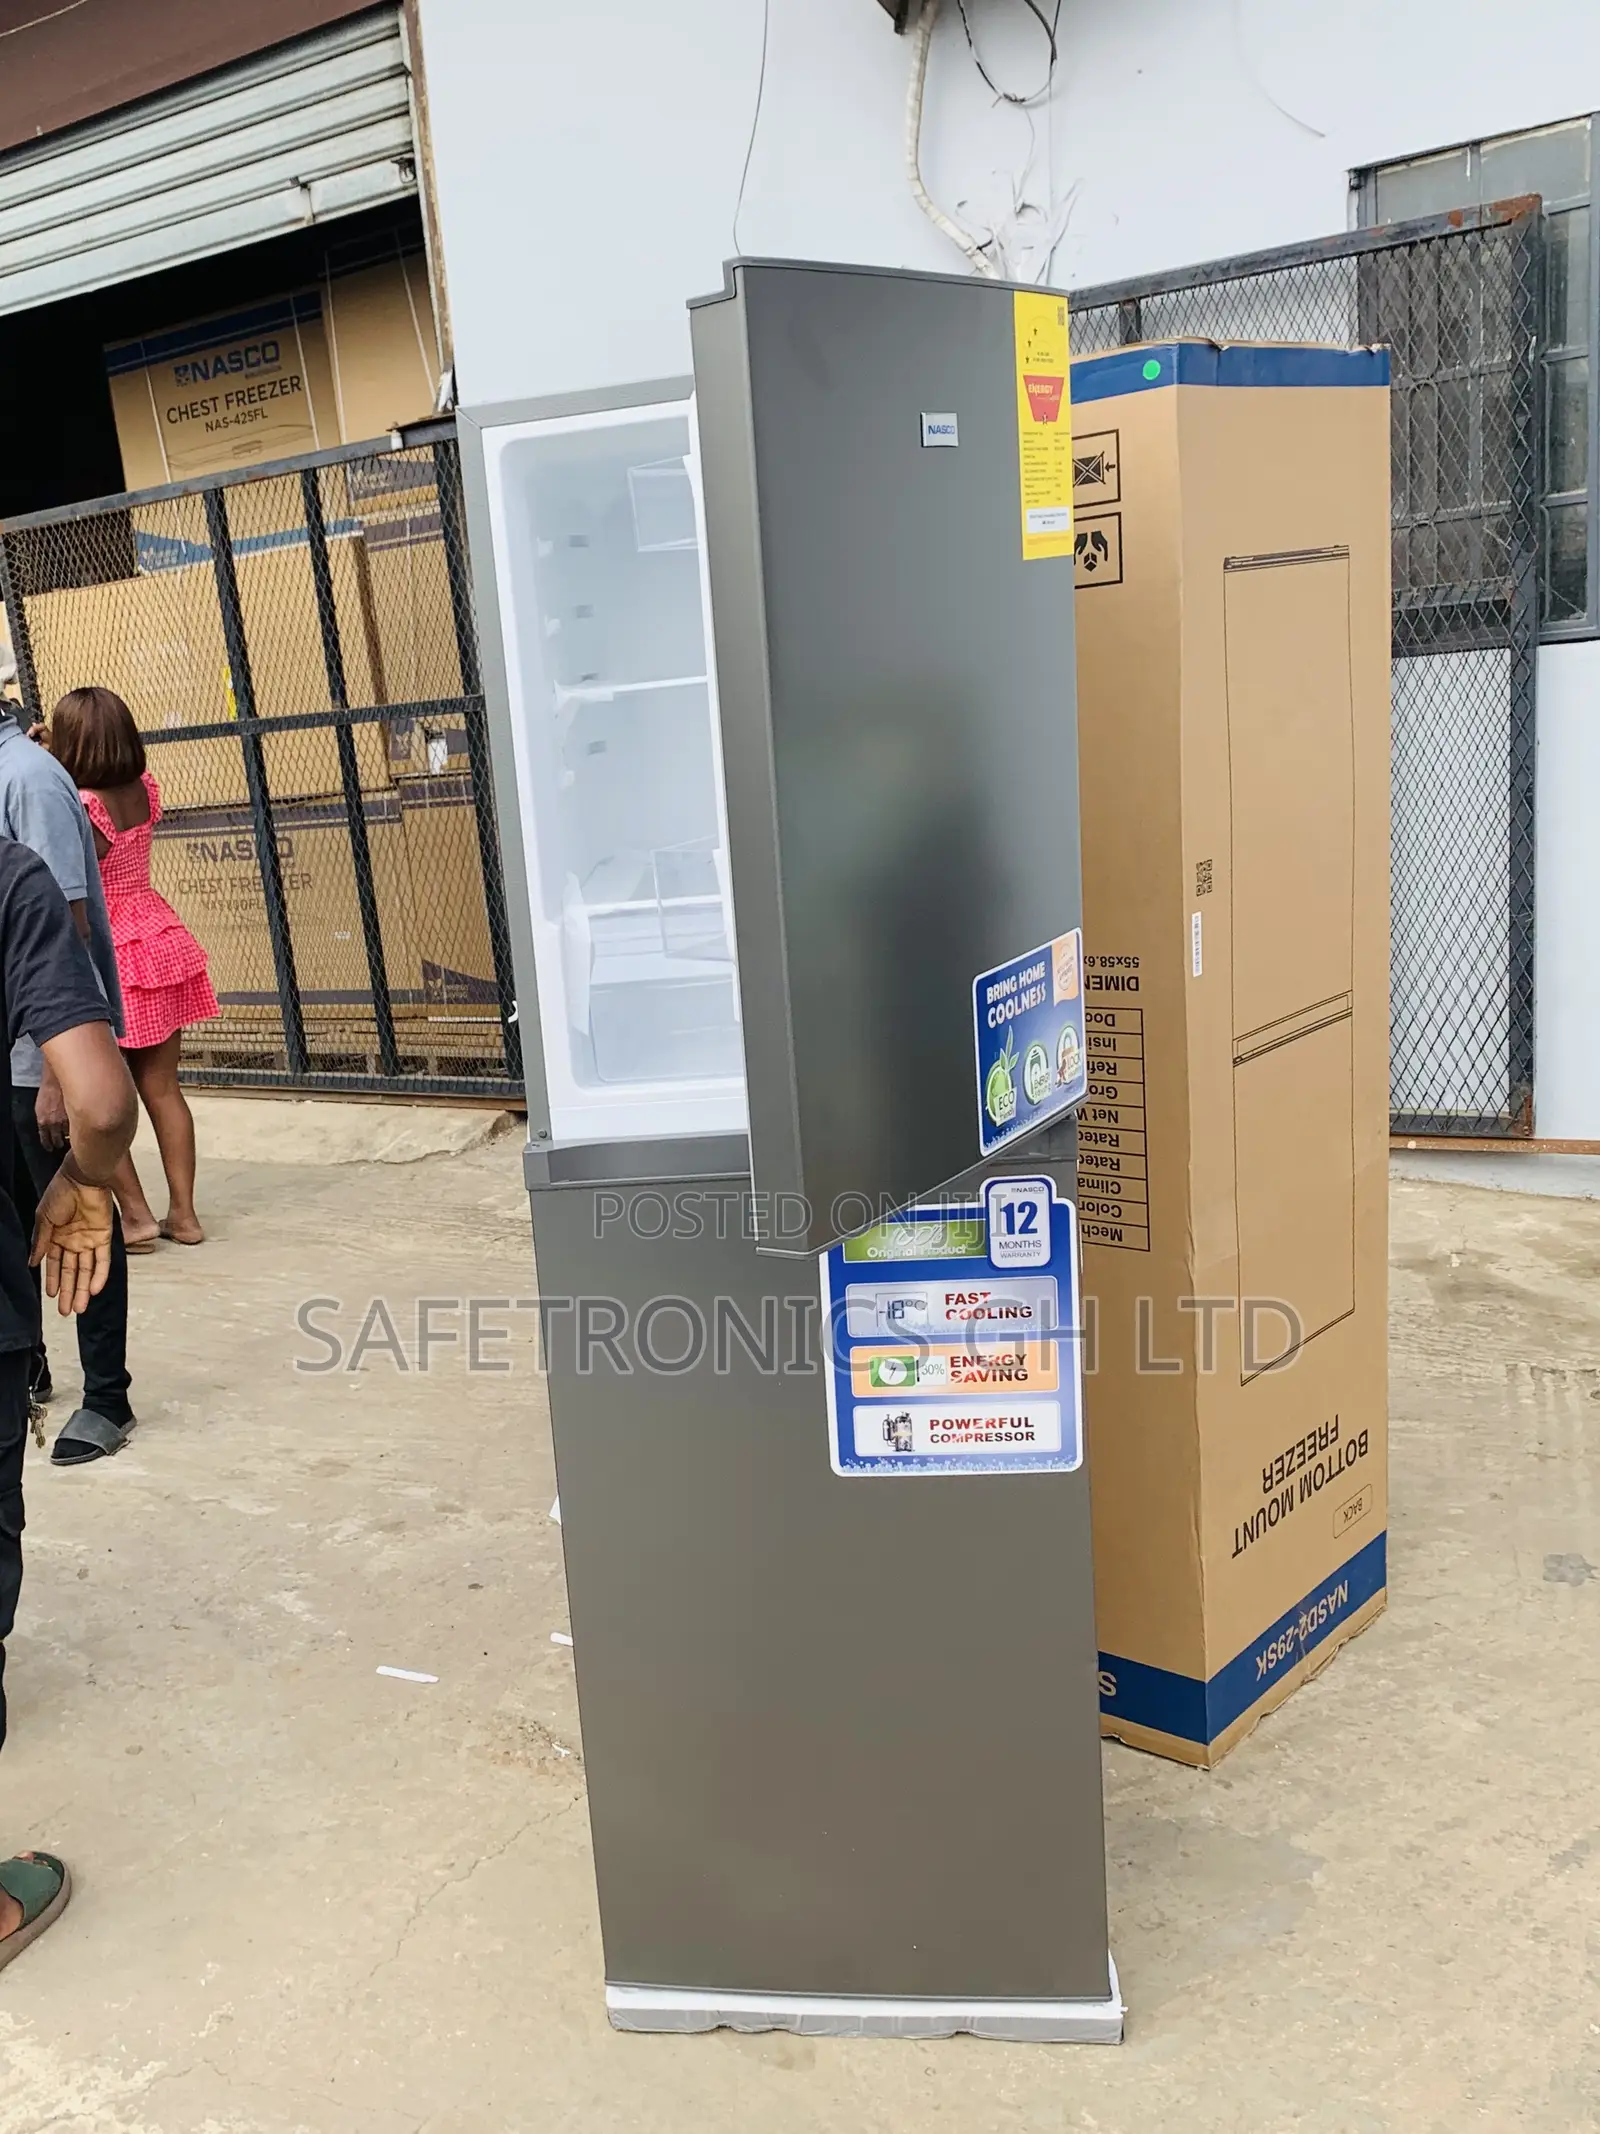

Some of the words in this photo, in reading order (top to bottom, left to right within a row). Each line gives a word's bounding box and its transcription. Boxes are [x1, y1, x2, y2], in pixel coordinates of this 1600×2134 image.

[190, 341, 279, 383] NASCO
[166, 397, 219, 424] CHEST
[225, 375, 302, 411] FREEZER
[205, 406, 268, 433] NAS-425FL
[928, 425, 955, 434] NASCO
[200, 836, 293, 862] NASO
[178, 878, 222, 895] CHEST
[986, 975, 1017, 1005] BRING
[1019, 961, 1046, 989] HOME
[987, 981, 1046, 1029] COOLNESS
[1088, 1036, 1116, 1051] Insi
[999, 1090, 1014, 1110] ECO
[1089, 1084, 1118, 1100] Gro
[1092, 1109, 1119, 1124] Net
[1078, 1177, 1121, 1195] Clima
[1000, 1201, 1038, 1235] 12
[1080, 1201, 1122, 1219] Color
[1081, 1224, 1123, 1242] Mech
[866, 1246, 917, 1259] Original
[999, 1239, 1042, 1250] MONTHS
[1000, 1250, 1041, 1259] WARRANTY
[945, 1292, 991, 1306] FAST
[945, 1306, 1033, 1321] COOLING
[921, 1363, 945, 1376] 30%
[950, 1354, 1027, 1368] ENERGY
[950, 1368, 1028, 1383] SAVING
[929, 1417, 1035, 1431] POWERFUL
[930, 1431, 1036, 1444] COMPRESSOR
[1262, 1413, 1339, 1494] FREEZER
[1300, 1429, 1369, 1504] BOTTOM
[1343, 1497, 1363, 1524] BACK
[1231, 1484, 1294, 1559] MOUNT
[1255, 1579, 1349, 1682] NASD2-29SK
